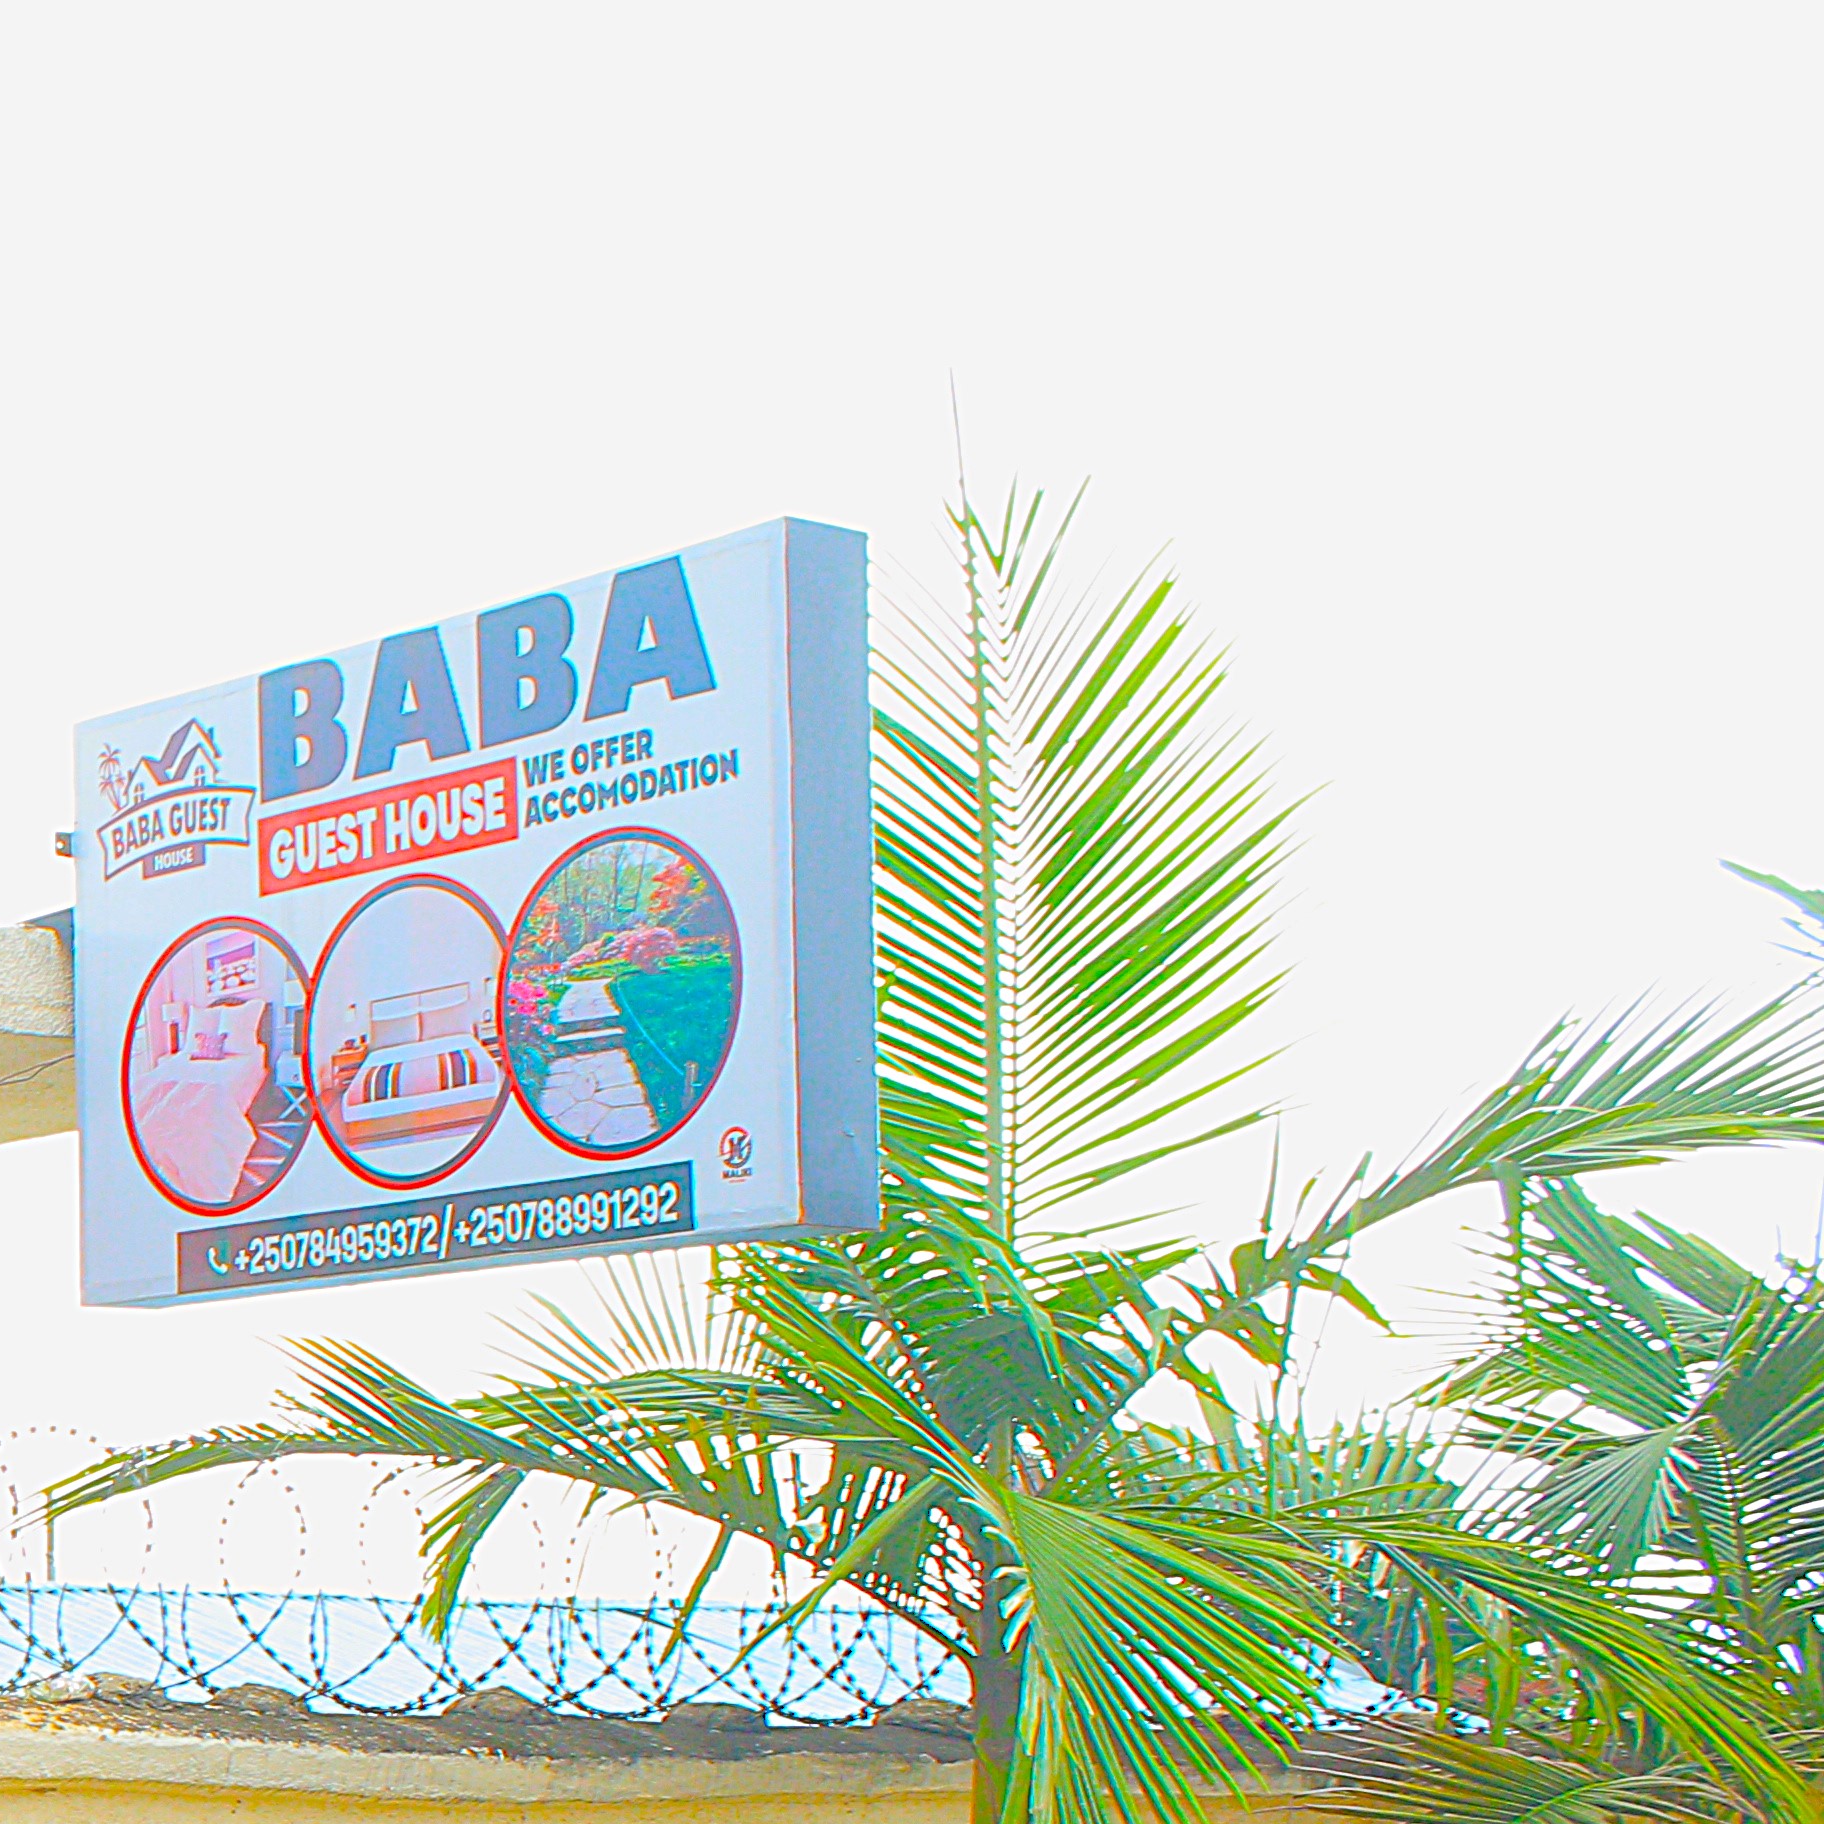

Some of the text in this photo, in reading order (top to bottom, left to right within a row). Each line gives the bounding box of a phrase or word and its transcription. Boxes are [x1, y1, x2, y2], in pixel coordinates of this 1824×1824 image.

[259, 555, 716, 803] BABA
[523, 728, 654, 788] WE OFFER
[524, 748, 740, 828] ACCOMODATION
[111, 798, 231, 860] BABA GUEST
[154, 849, 194, 871] HOUSE
[269, 777, 507, 879] GUEST HOUSE
